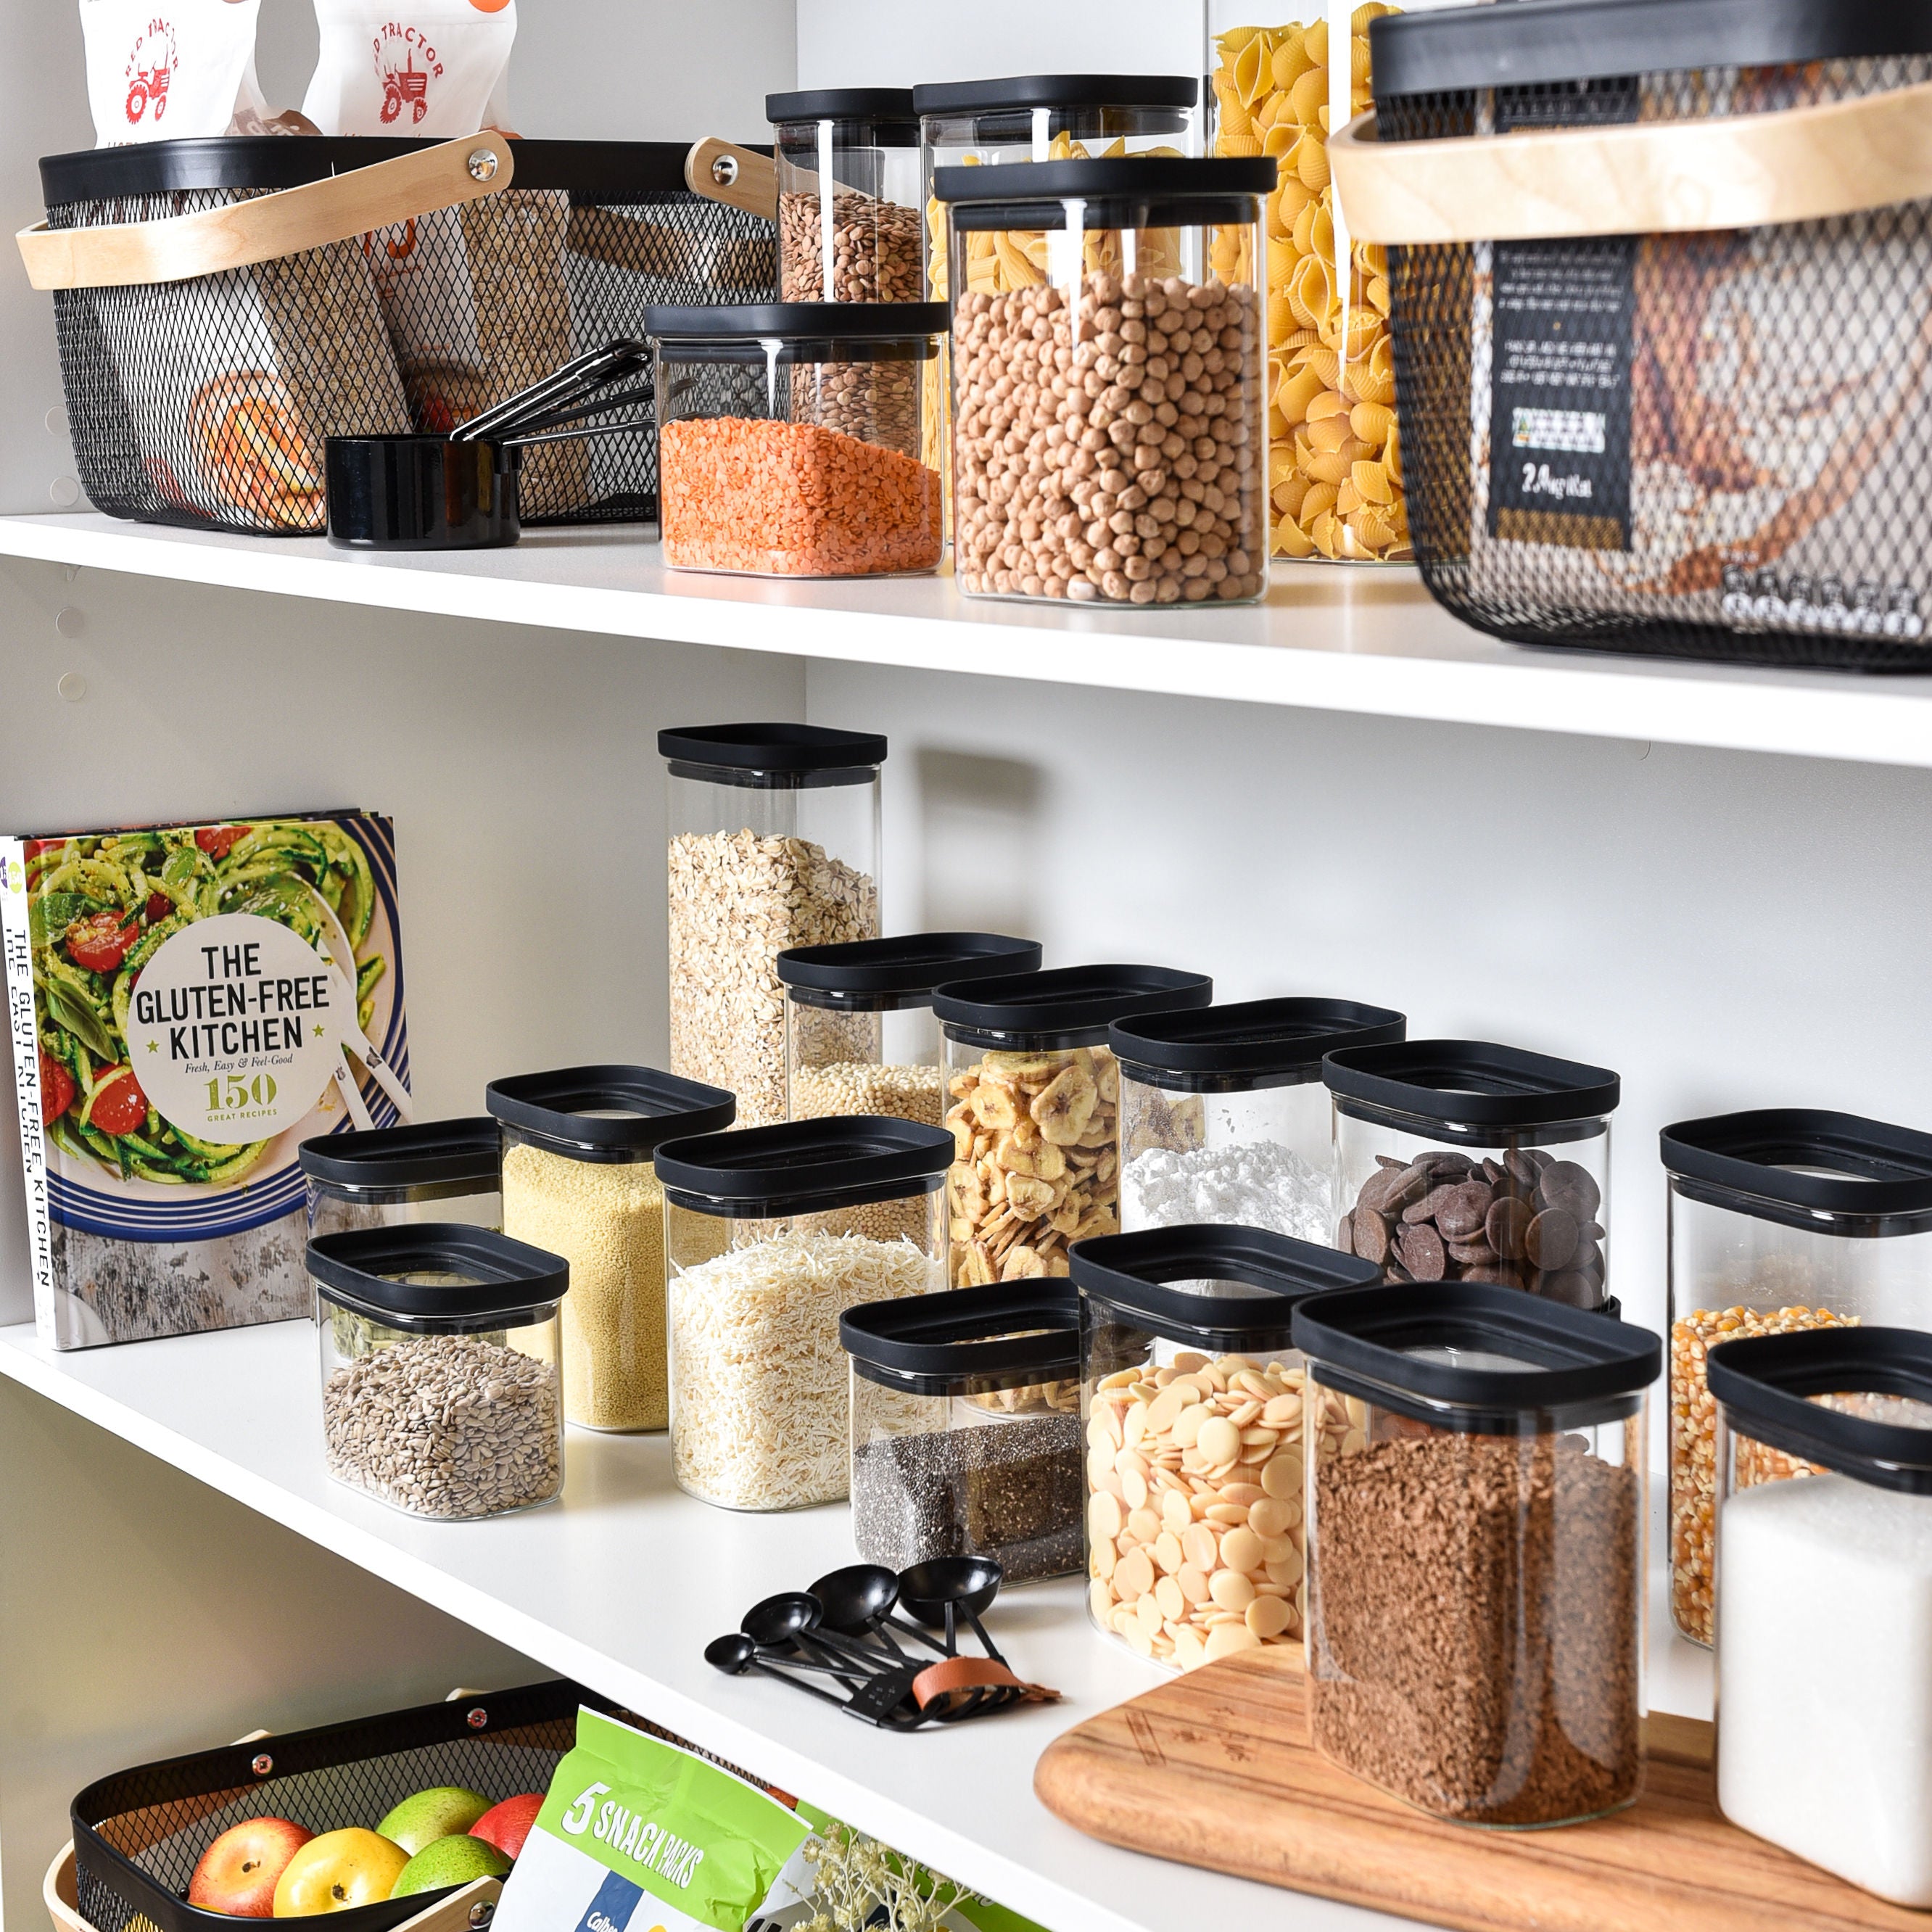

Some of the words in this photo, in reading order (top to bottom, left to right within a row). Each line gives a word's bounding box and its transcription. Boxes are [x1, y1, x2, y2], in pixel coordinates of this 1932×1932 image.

[381, 22, 444, 79] TRACTOR
[15, 929, 28, 977] THE
[201, 943, 262, 979] THE
[136, 975, 330, 1025] GLUTEN-FREE
[170, 1015, 302, 1060] KITCHEN
[19, 991, 42, 1166] GLUTEN-FREE
[185, 1062, 210, 1073] Fresh,
[214, 1060, 235, 1073] Easy
[238, 1057, 248, 1068] &
[251, 1053, 293, 1068] Feel-Good
[203, 1073, 277, 1112] 150
[207, 1112, 236, 1123] GREAT
[240, 1108, 278, 1119] RECIPES
[33, 1178, 49, 1287] KITCHEN
[561, 1781, 613, 1836] 5
[593, 1800, 668, 1869] SNACK
[654, 1833, 704, 1889] PACKS
